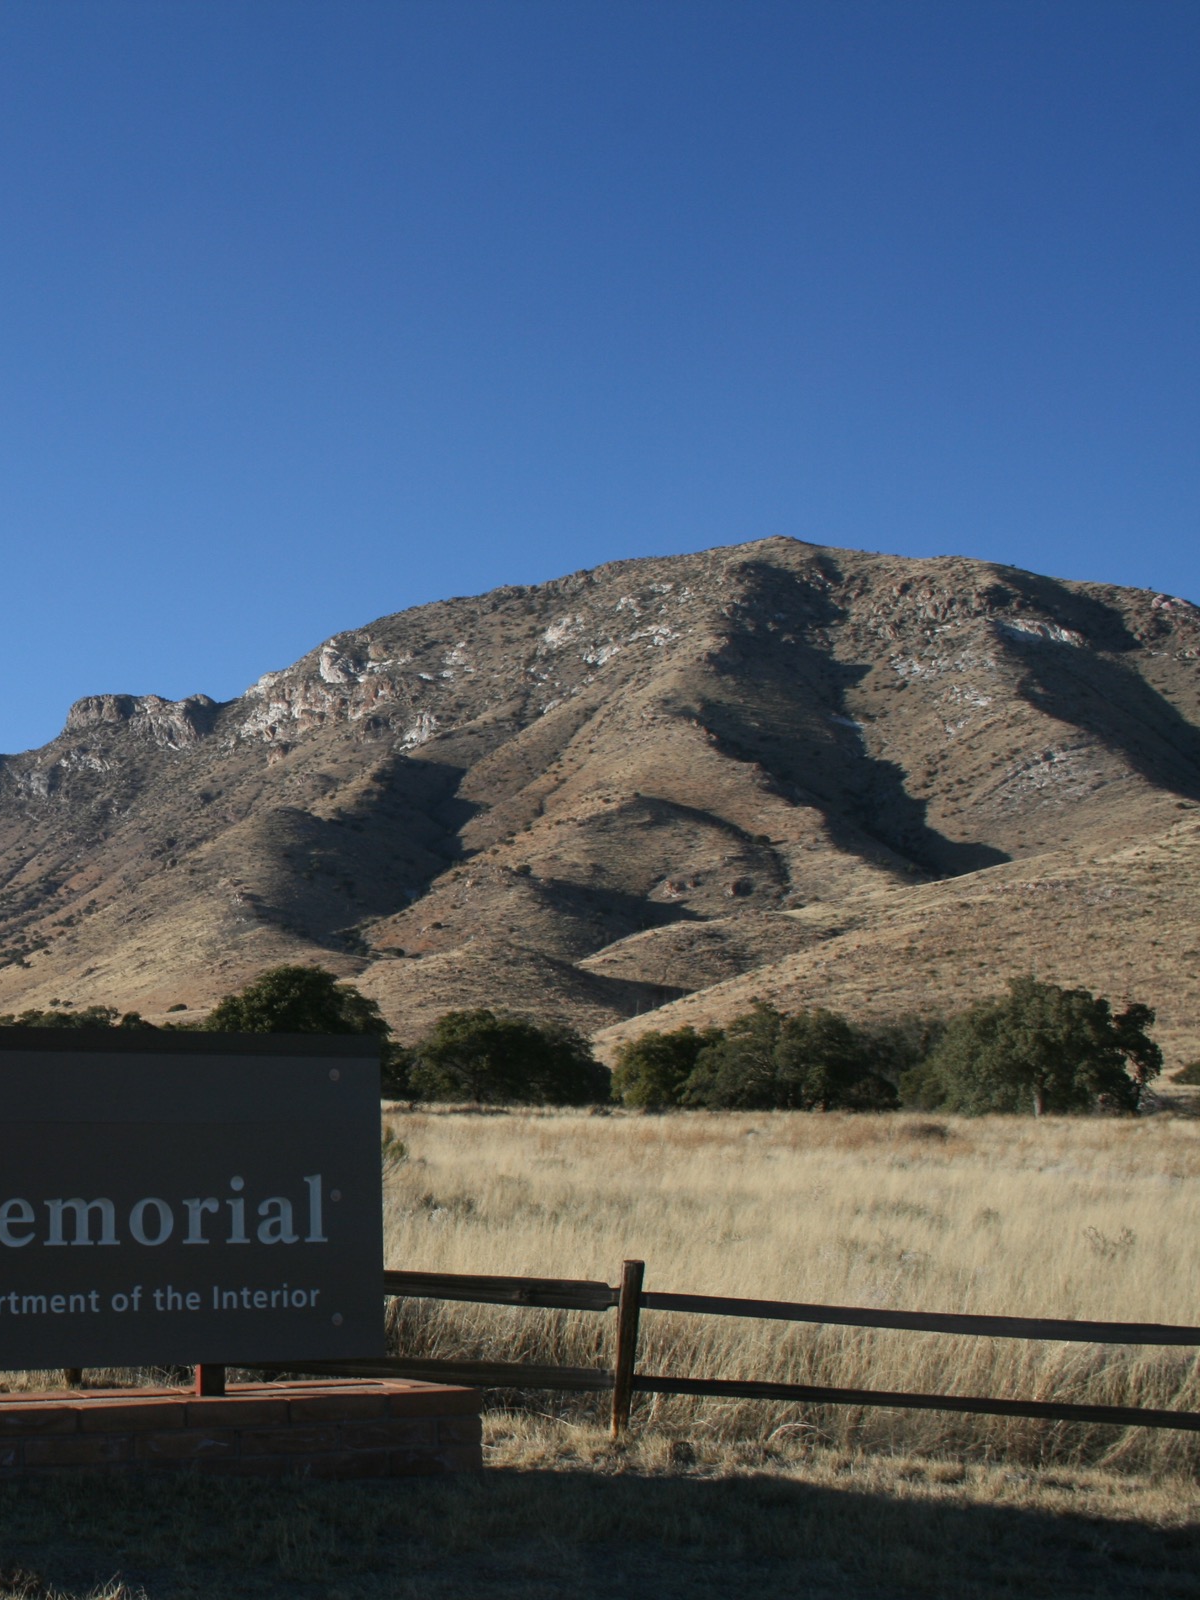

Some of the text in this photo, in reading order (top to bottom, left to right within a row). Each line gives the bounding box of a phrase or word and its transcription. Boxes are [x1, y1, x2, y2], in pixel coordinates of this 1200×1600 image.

[111, 1285, 143, 1312] of
[152, 1284, 201, 1312] the
[213, 1282, 321, 1310] Interior
